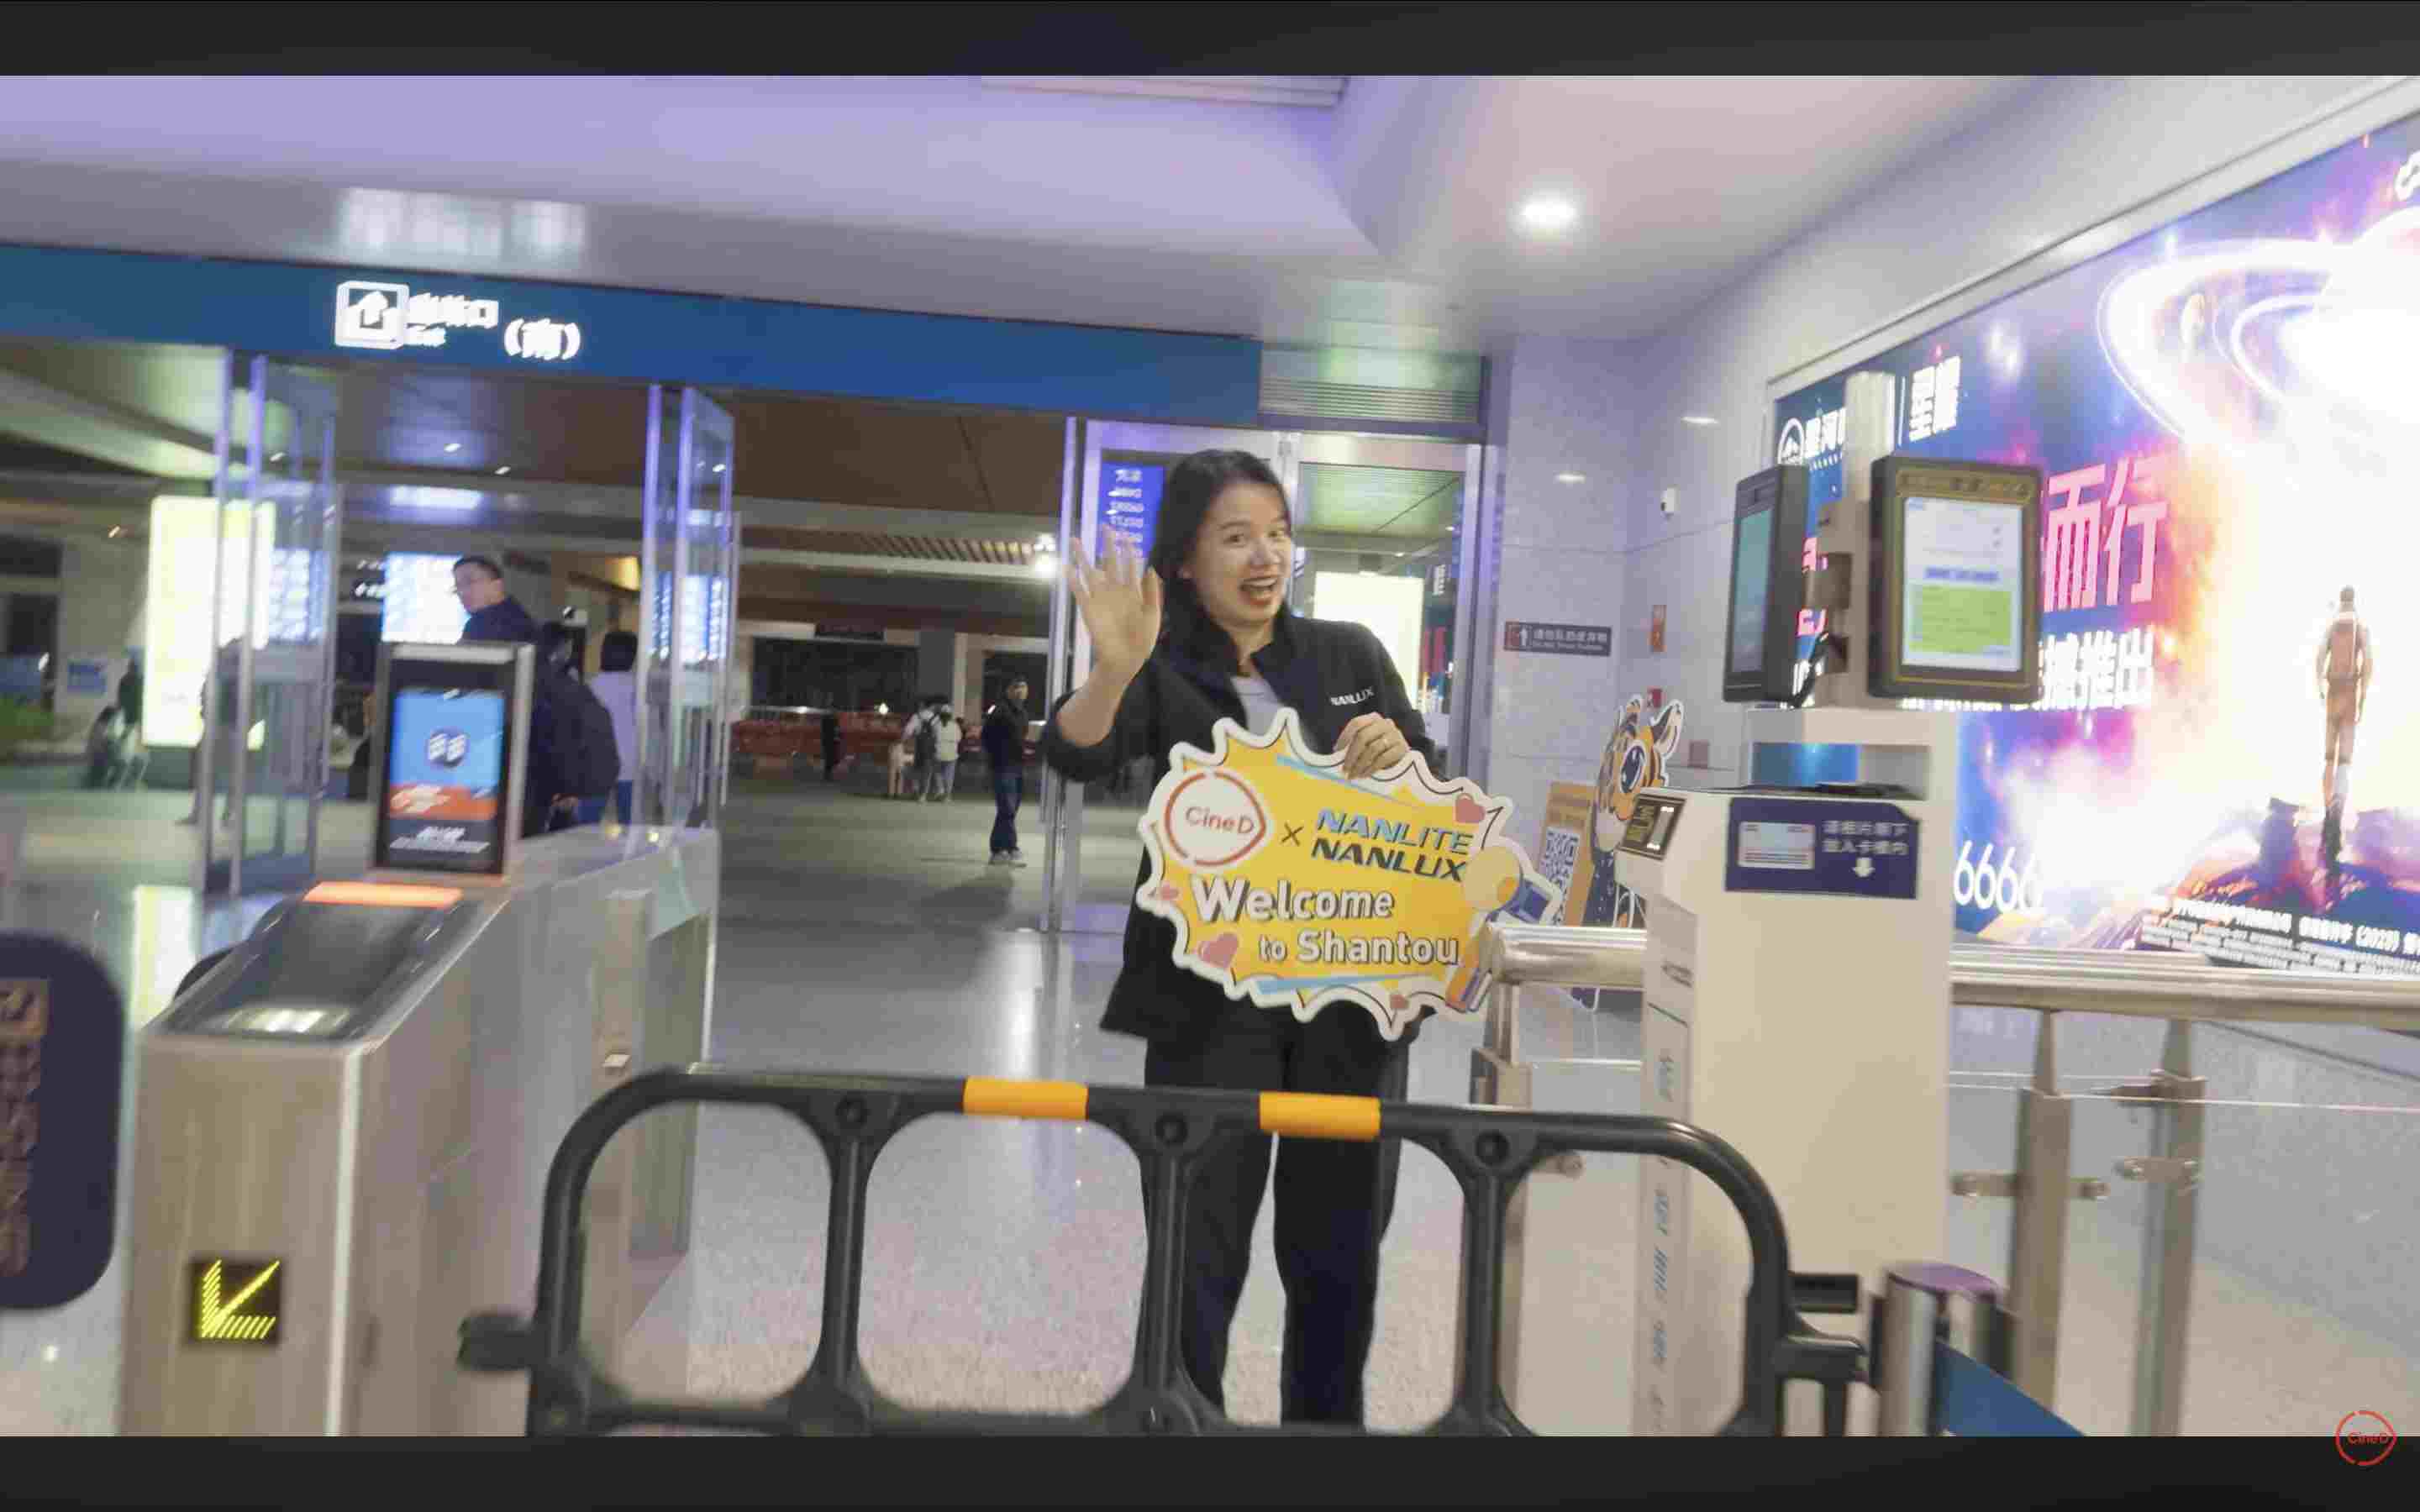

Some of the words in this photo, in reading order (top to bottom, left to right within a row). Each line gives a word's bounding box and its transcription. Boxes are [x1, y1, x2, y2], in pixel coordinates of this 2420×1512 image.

[1185, 805, 1255, 836] CineD
[1316, 807, 1474, 854] NANLITE
[1311, 837, 1466, 882] NANLUX
[1191, 876, 1395, 922] Welcome
[1260, 934, 1287, 962] to
[1297, 930, 1459, 966] Shantou
